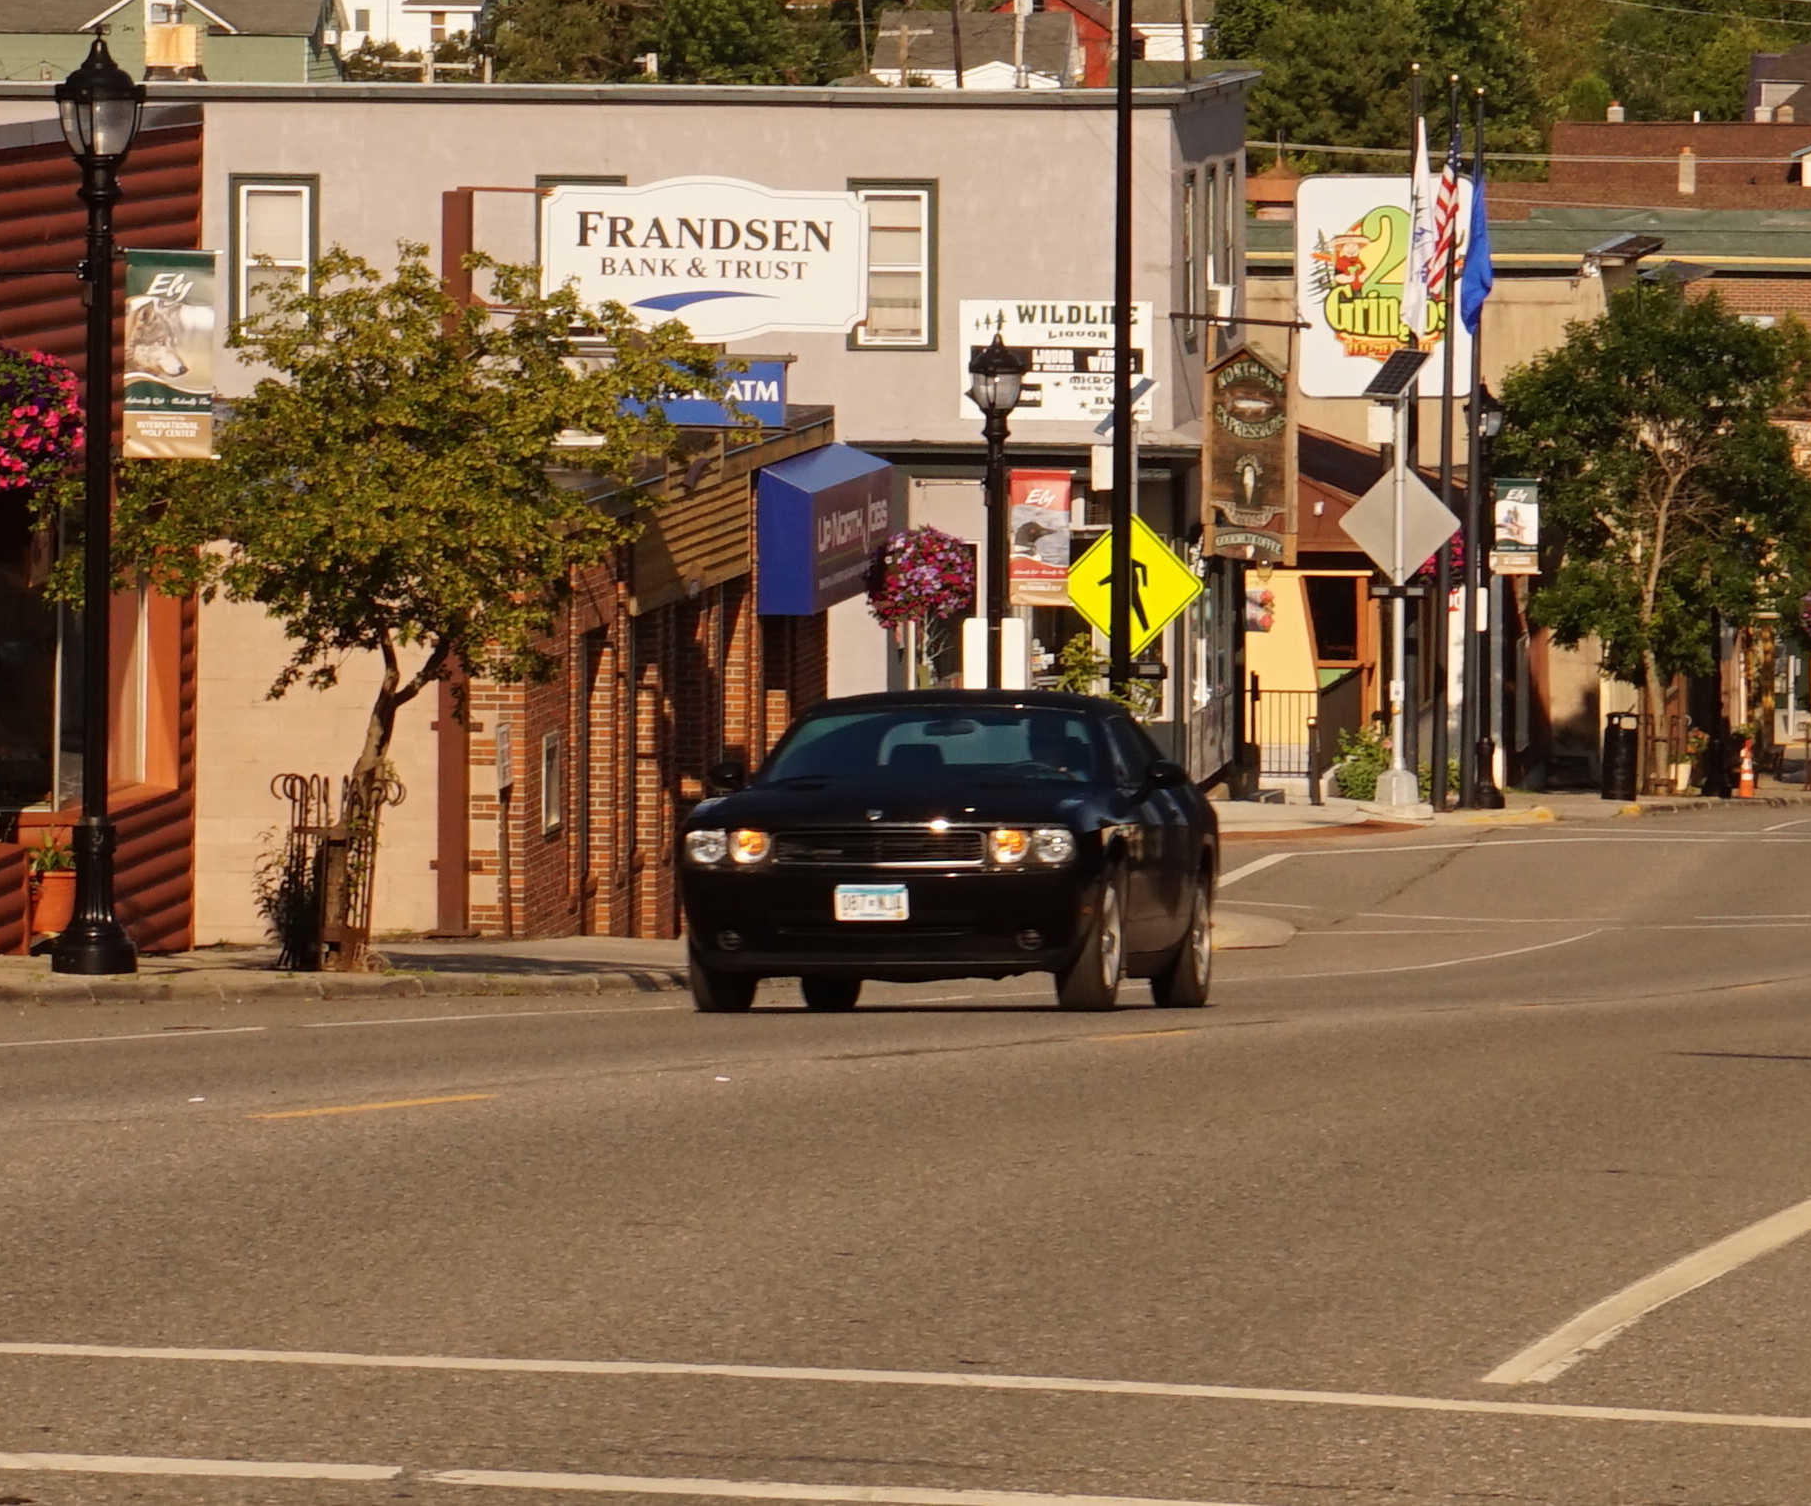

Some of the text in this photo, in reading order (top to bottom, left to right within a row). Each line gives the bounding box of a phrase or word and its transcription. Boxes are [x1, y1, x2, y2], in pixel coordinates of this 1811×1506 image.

[576, 210, 833, 252] FRANDSEN
[1362, 205, 1409, 297] 2
[600, 257, 808, 281] BANK & TRUST
[146, 273, 194, 307] Ely
[1016, 305, 1139, 325] WILDLIE
[1048, 330, 1109, 339] LIQUOR
[725, 380, 779, 402] ATM
[1025, 488, 1056, 508] Ely
